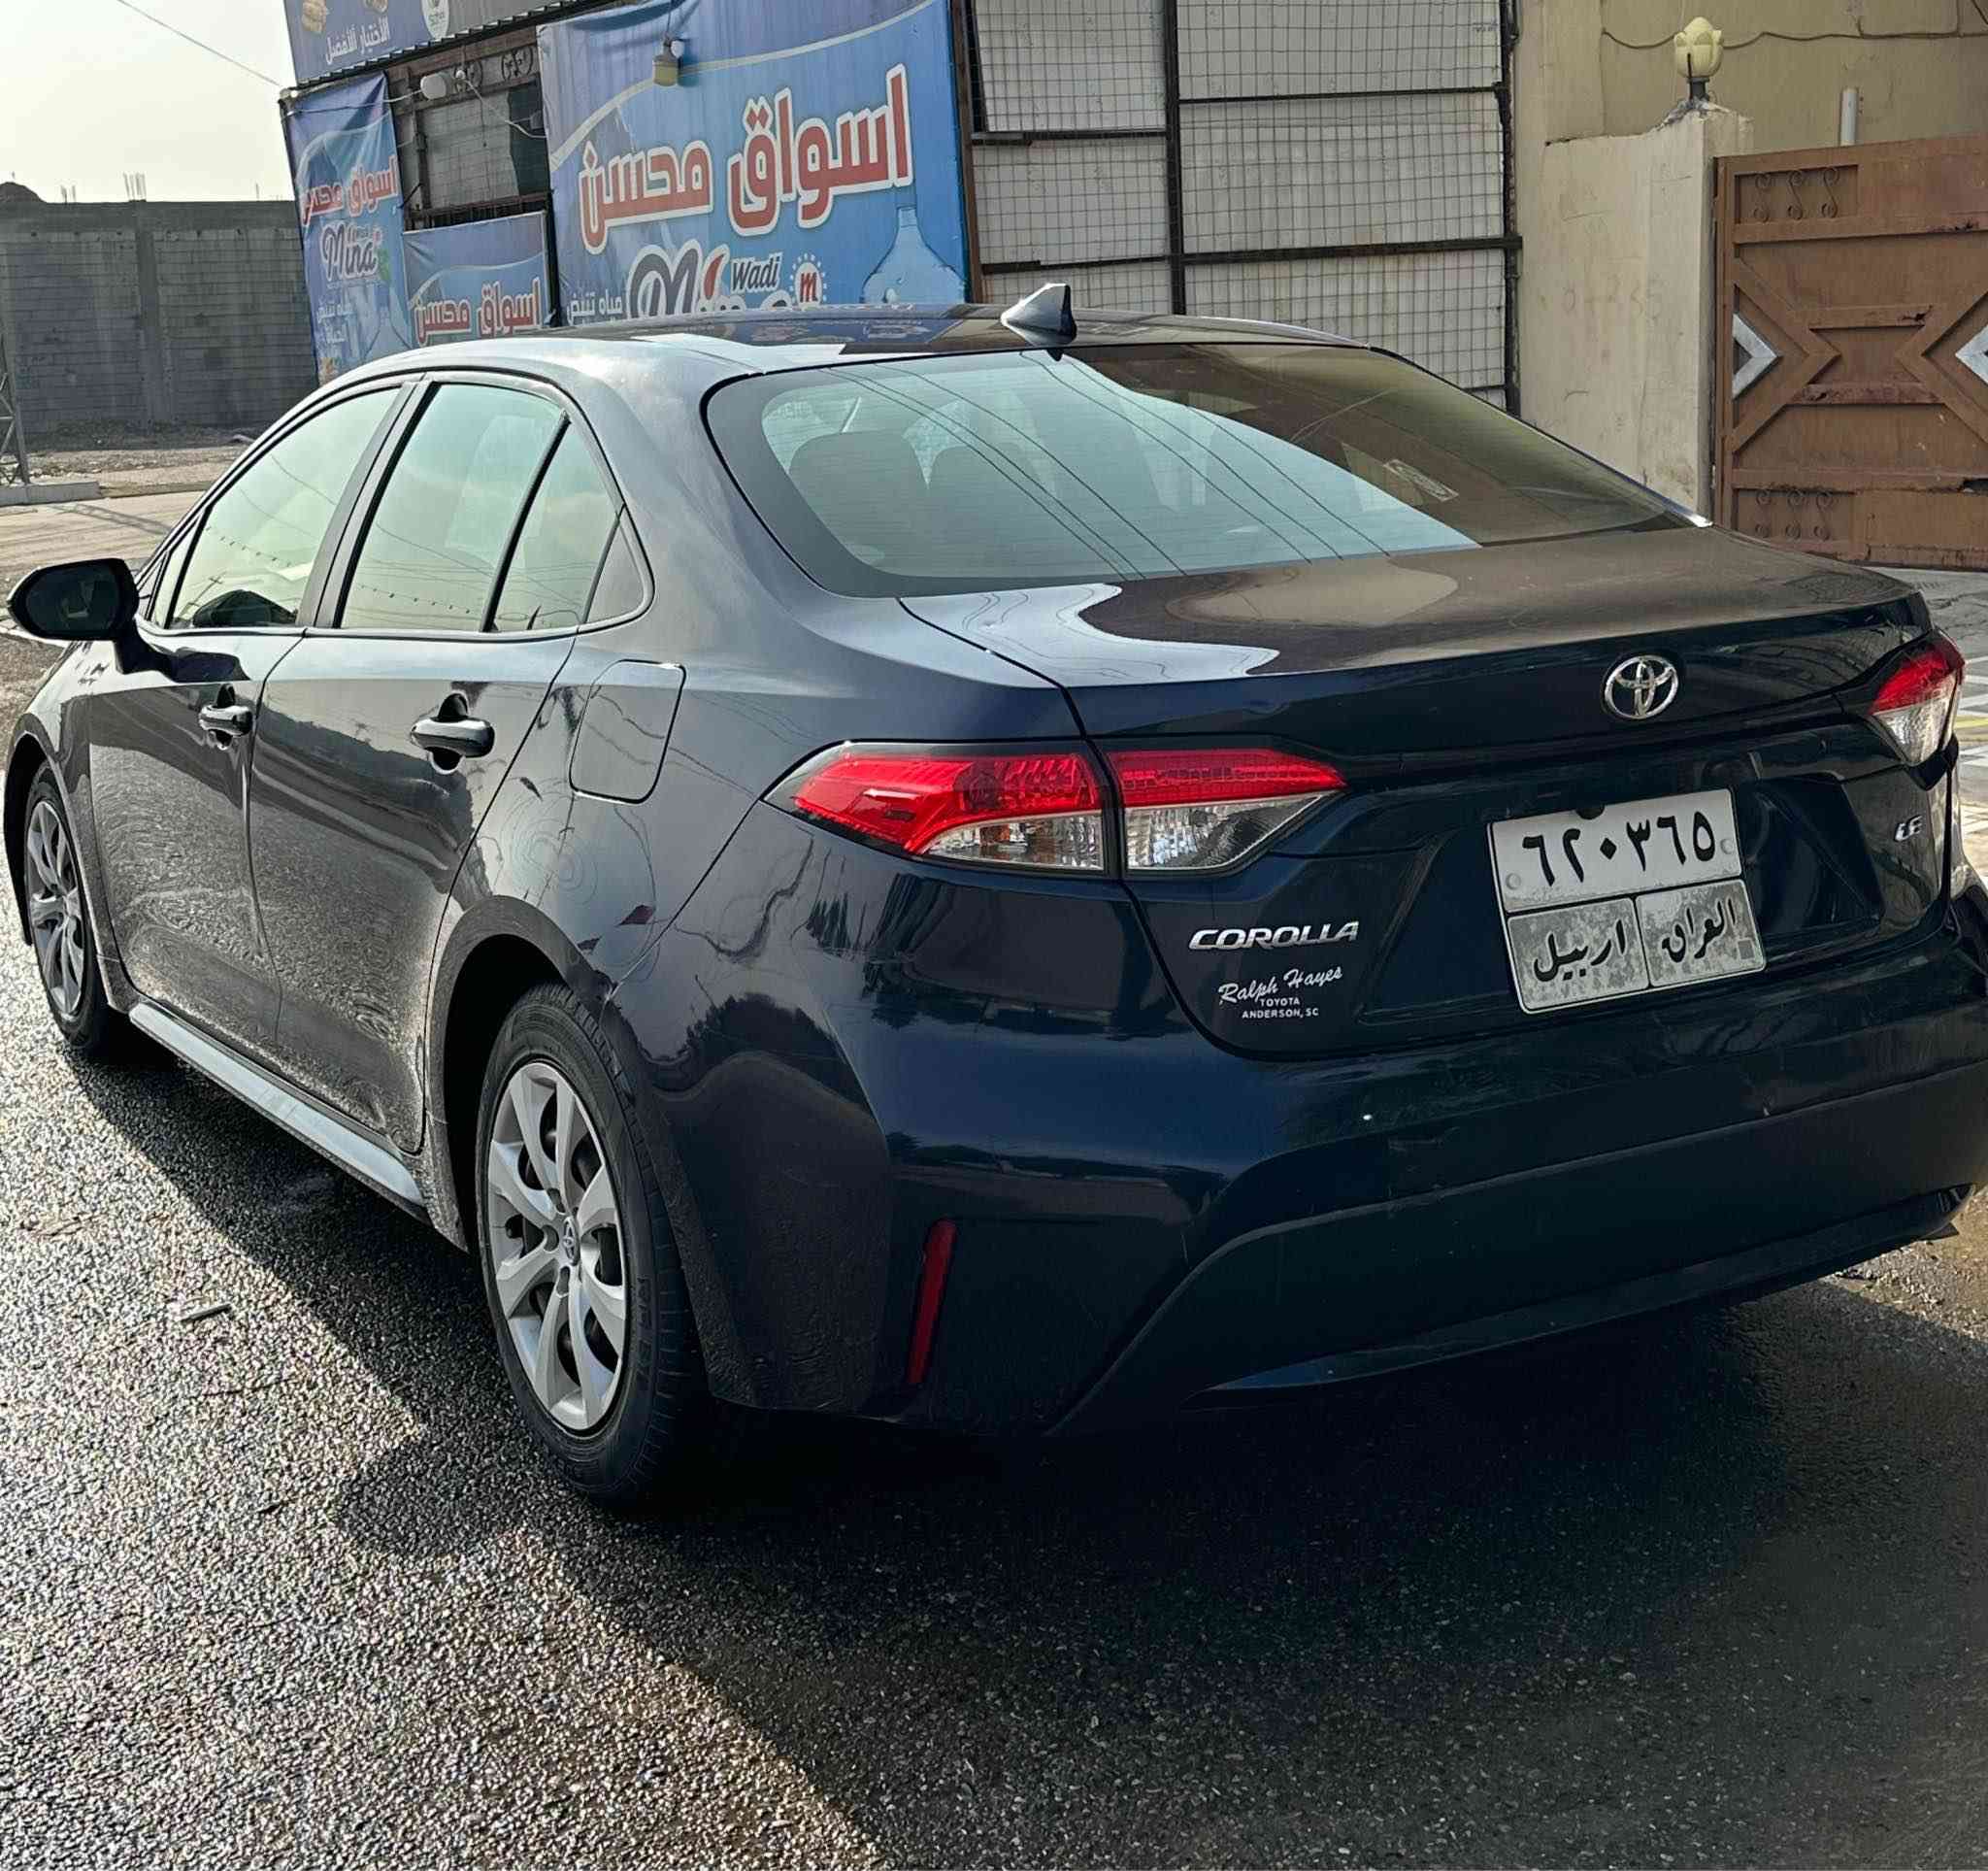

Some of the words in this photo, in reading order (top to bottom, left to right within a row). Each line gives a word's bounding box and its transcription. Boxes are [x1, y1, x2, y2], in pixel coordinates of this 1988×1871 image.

[728, 65, 911, 235] اسواق
[580, 141, 713, 254] محسن
[732, 254, 781, 290] Wadi
[1522, 810, 1715, 886] ٦٢٠٣٦٥
[1895, 816, 1922, 842] LE
[1189, 920, 1359, 950] COROLLA
[1661, 897, 1737, 963] العراق
[1534, 919, 1626, 984] اربيل
[1218, 976, 1278, 1005] Ralph
[1283, 966, 1342, 988] Hayes
[1260, 996, 1301, 1007] TOYOTA
[1242, 1009, 1304, 1019] ANDERSON,
[1305, 1008, 1319, 1017] SC
